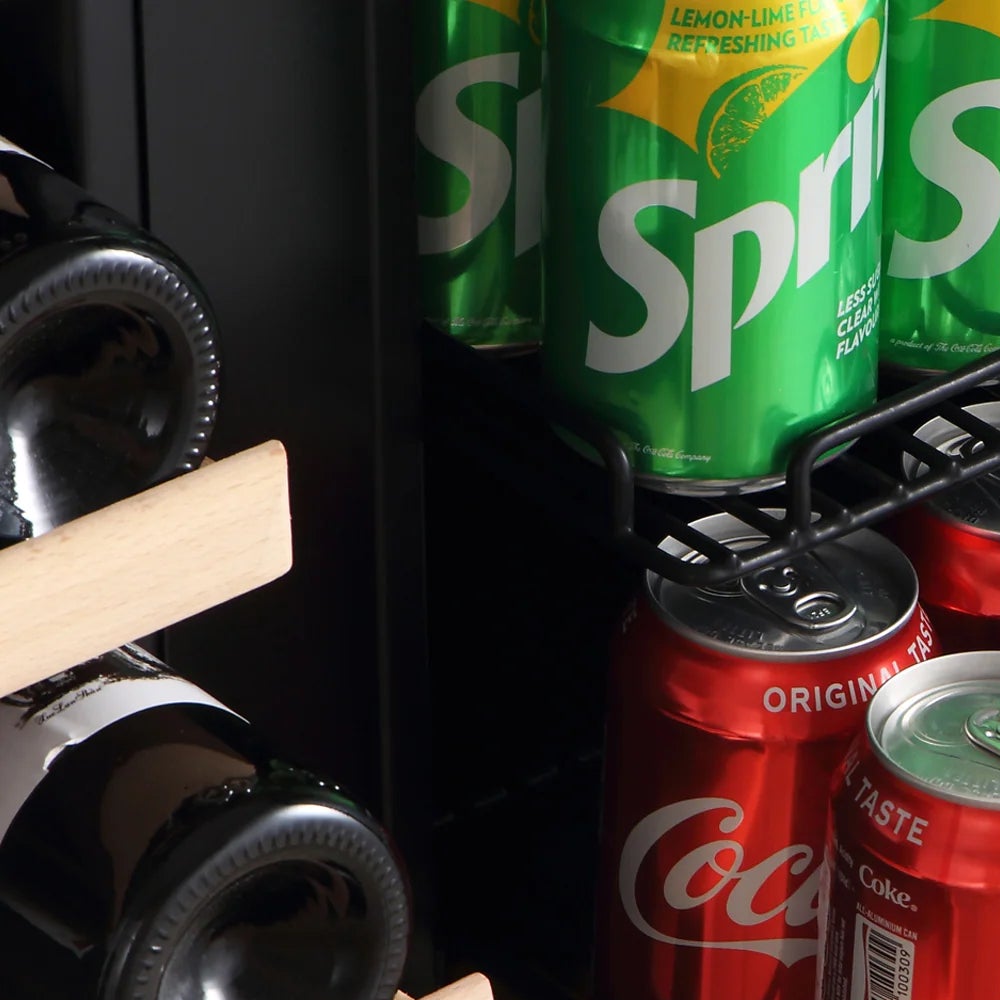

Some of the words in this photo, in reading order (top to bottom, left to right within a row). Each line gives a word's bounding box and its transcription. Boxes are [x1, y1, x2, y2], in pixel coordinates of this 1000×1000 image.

[667, 30, 796, 54] REFRESHING
[798, 10, 849, 44] TASE
[670, 2, 795, 29] LEMON-LIME
[837, 284, 867, 318] LESS
[837, 297, 873, 337] CLEAR
[907, 602, 934, 664] TAST
[854, 776, 929, 846] TASTE
[903, 927, 918, 943] CAN
[897, 949, 912, 997] 100309
